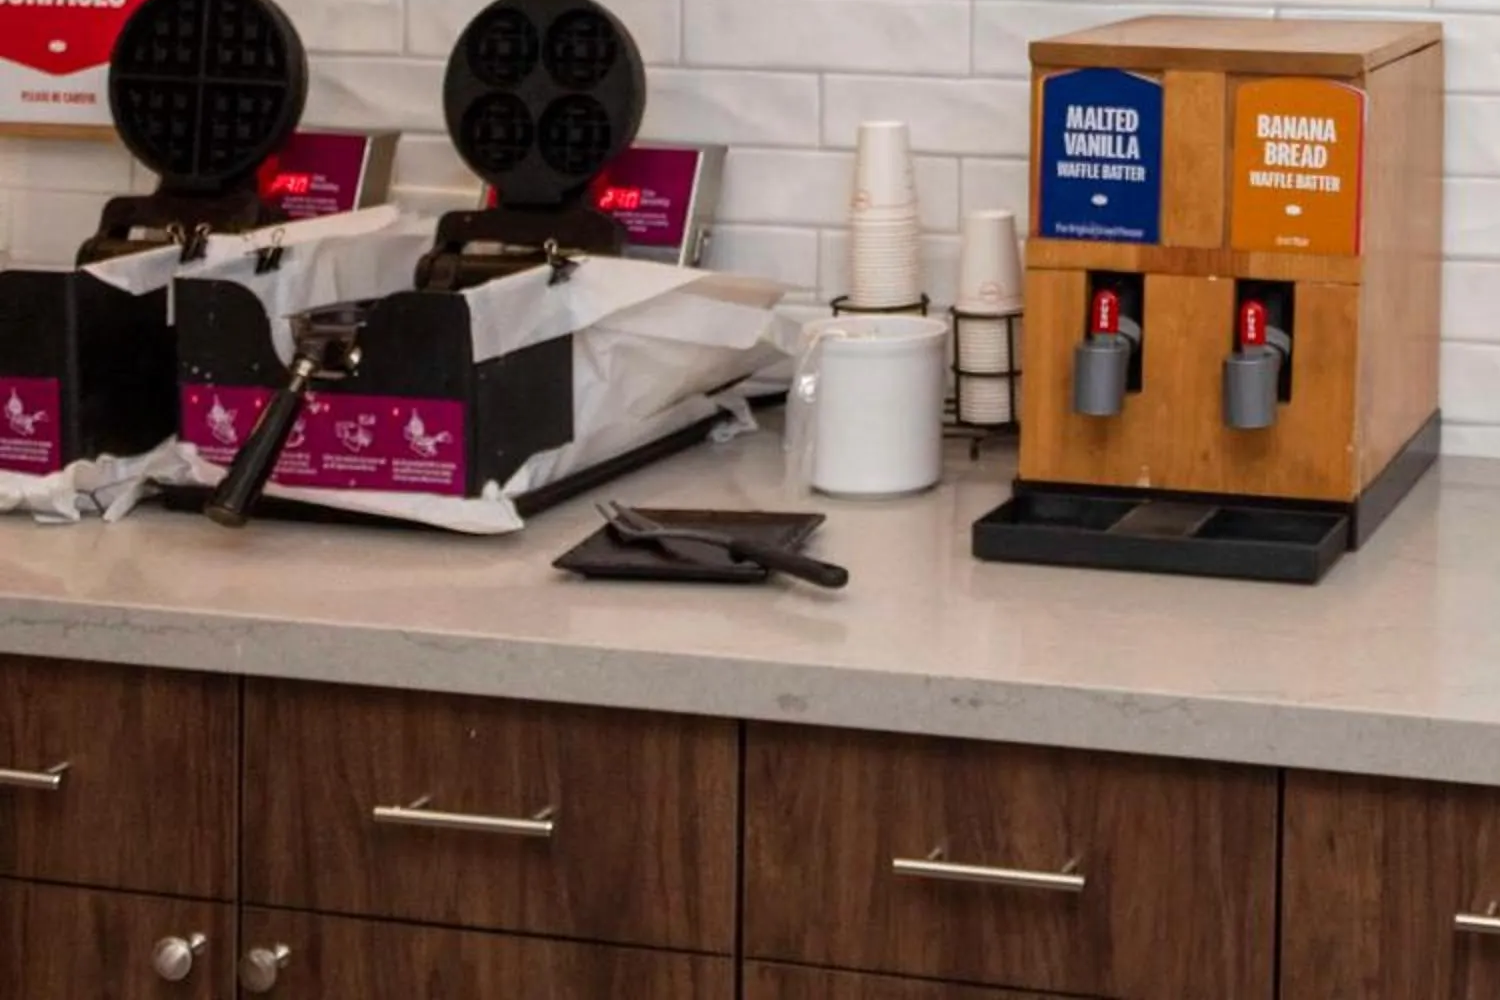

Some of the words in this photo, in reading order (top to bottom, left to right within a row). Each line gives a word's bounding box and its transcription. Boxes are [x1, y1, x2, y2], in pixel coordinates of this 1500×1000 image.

[1066, 105, 1139, 133] MALTED
[1256, 114, 1337, 143] BANANA
[1064, 132, 1140, 160] VANILLA
[1263, 142, 1327, 169] BREAD
[1057, 161, 1100, 179] WAFFLE
[1102, 164, 1145, 182] BATTER
[1249, 170, 1295, 190] WAFFLE
[1295, 174, 1341, 192] BATTER
